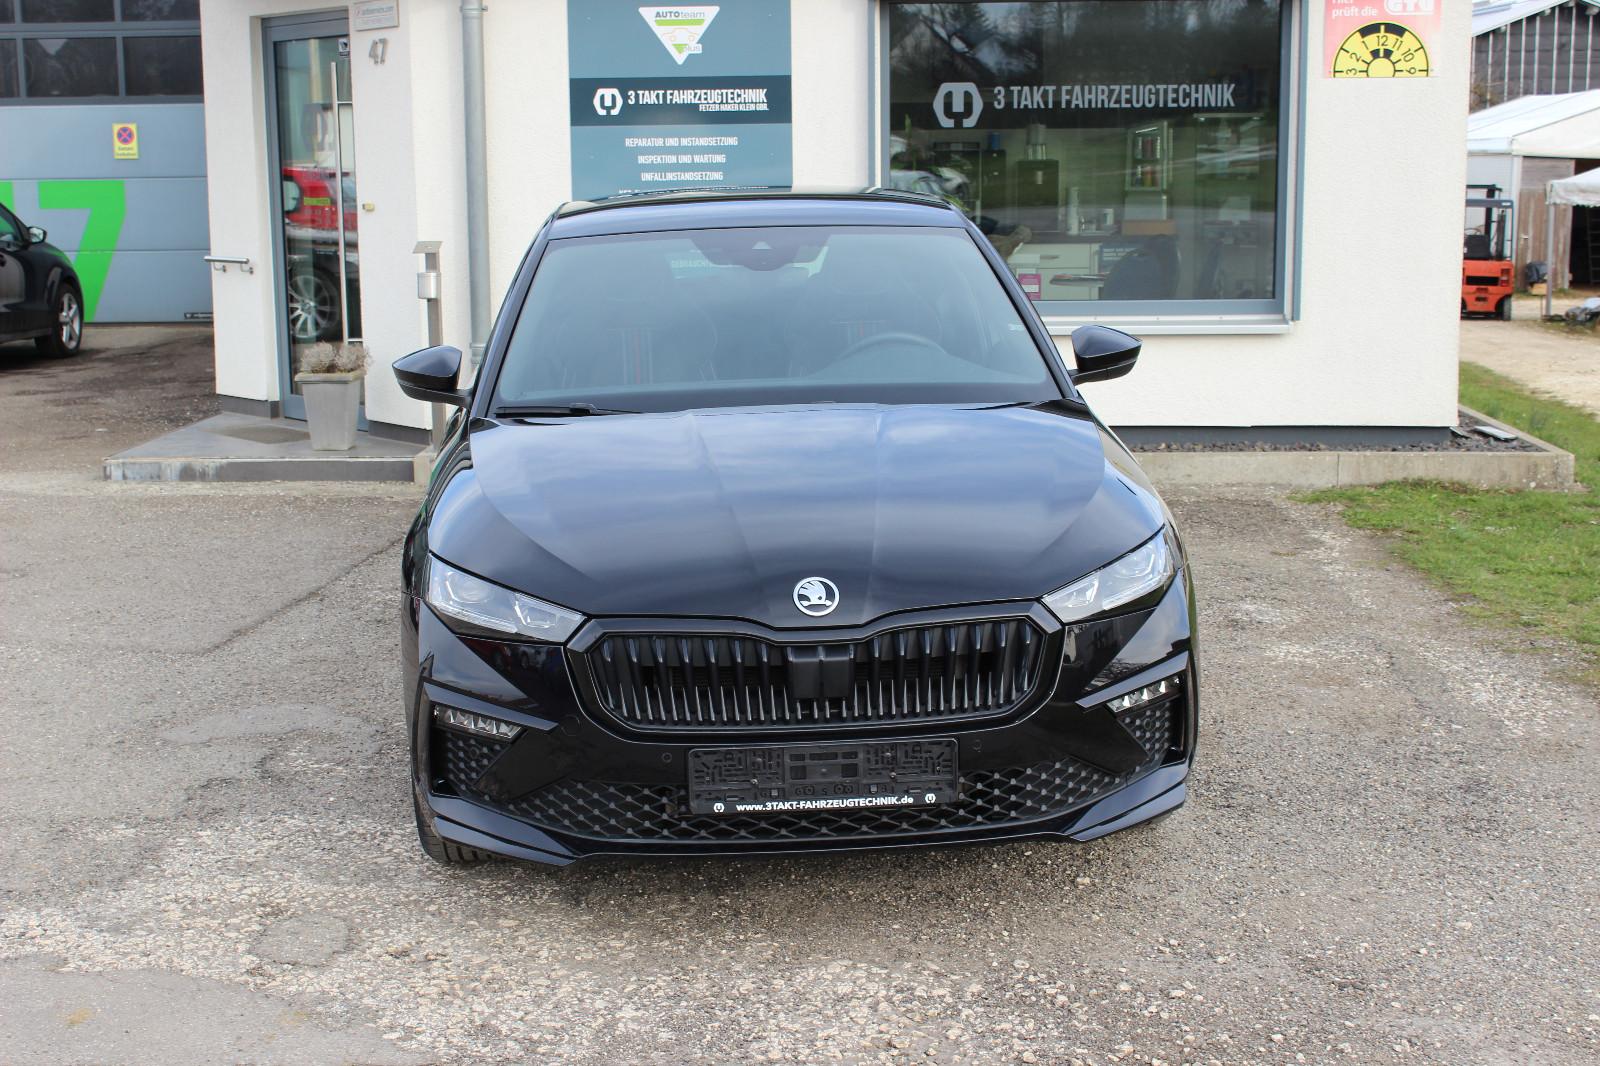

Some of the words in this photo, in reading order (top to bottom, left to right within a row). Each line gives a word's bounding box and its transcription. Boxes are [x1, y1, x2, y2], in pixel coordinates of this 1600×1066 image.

[655, 10, 705, 19] AUTOteam
[1332, 6, 1358, 19] prüft
[1361, 6, 1378, 17] die
[369, 38, 388, 65] 47
[1350, 52, 1362, 62] 2
[1362, 40, 1369, 50] 1
[1376, 35, 1389, 46] 12
[1392, 38, 1404, 50] 11
[1402, 48, 1414, 63] 10
[628, 91, 635, 105] 3
[638, 90, 664, 105] TAKT
[667, 89, 768, 104] FAHRZEUGTECHNIK
[993, 86, 1005, 109] 3
[1009, 85, 1057, 109] TAKT
[1060, 83, 1236, 109] FAHRZEUGTECHNIK
[625, 137, 664, 147] REPARATUR
[665, 137, 679, 146] UND
[681, 136, 739, 146] INSTANDSETZUNG
[638, 155, 677, 164] INSPEKTION
[678, 155, 692, 164] UND
[694, 154, 727, 164] WARTUNG
[641, 171, 723, 181] UNFALLINSTANDSETZUNG
[736, 795, 914, 812] www.3TAKT-FAHRZEUGTECHNIK.de
